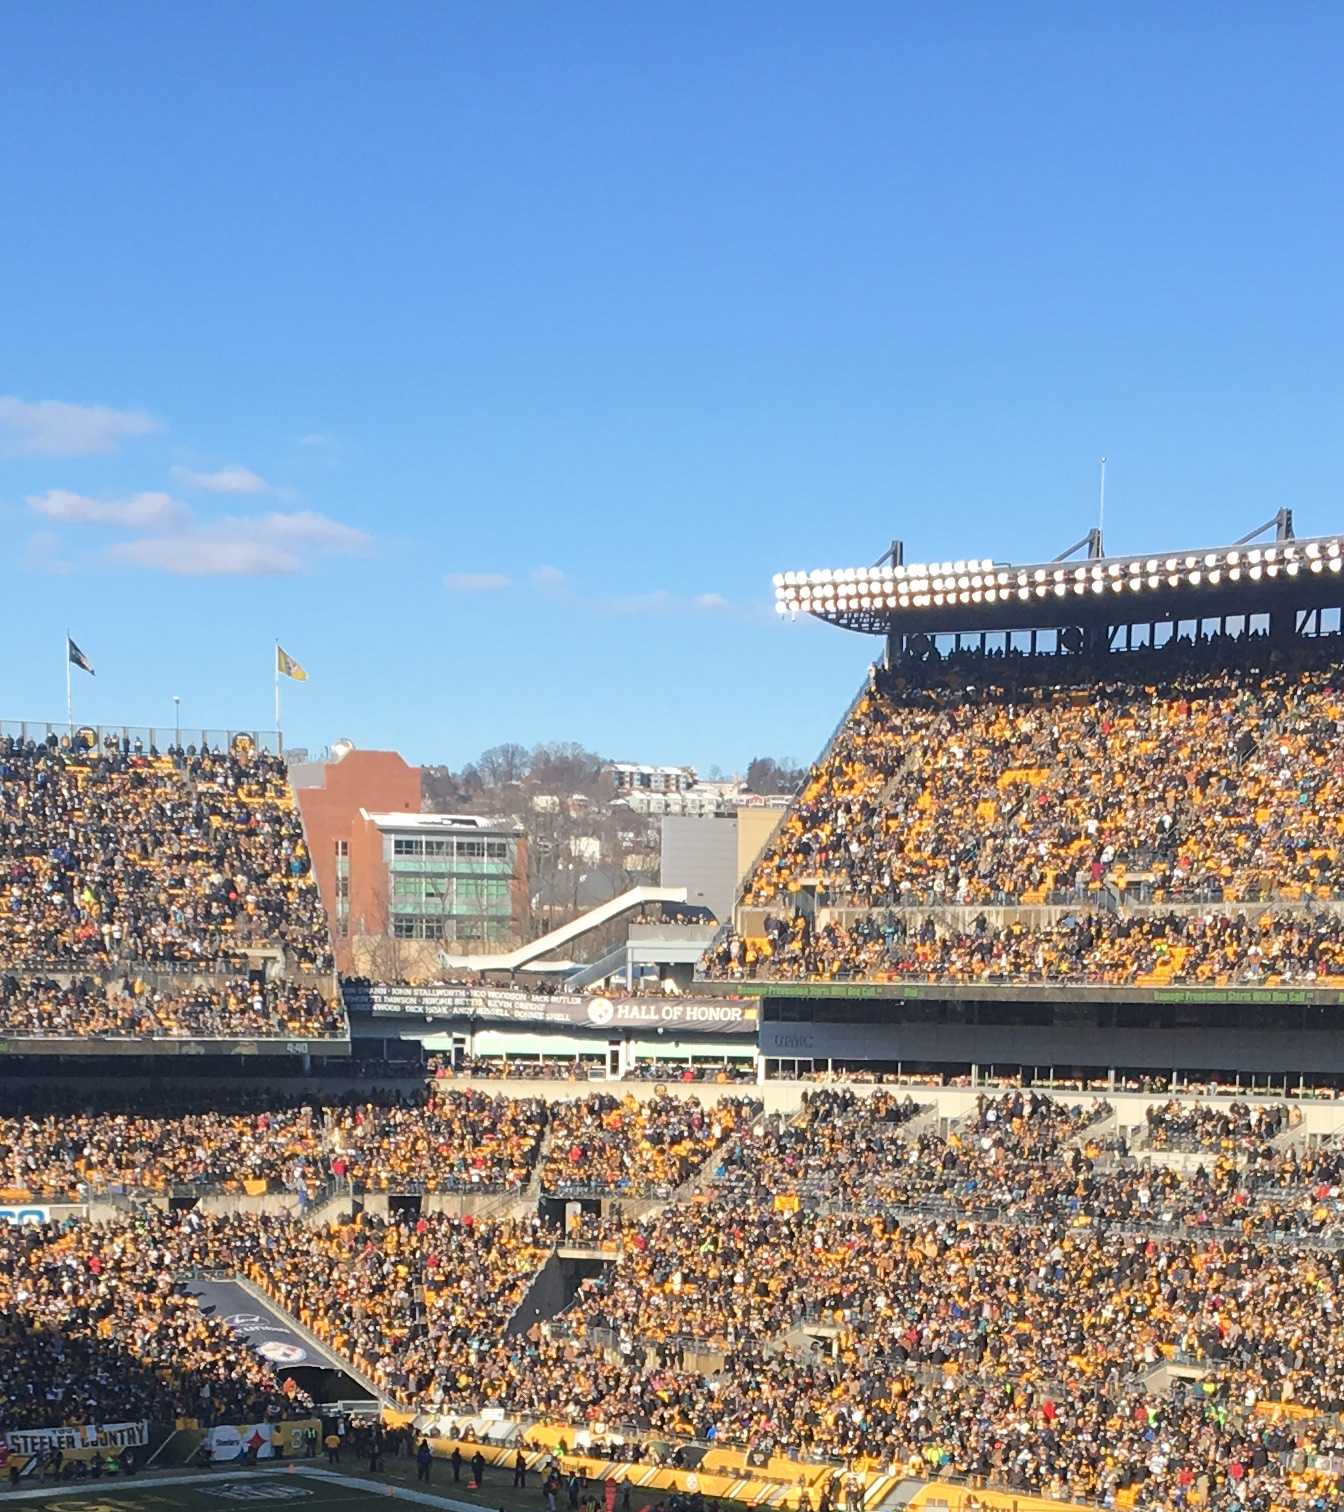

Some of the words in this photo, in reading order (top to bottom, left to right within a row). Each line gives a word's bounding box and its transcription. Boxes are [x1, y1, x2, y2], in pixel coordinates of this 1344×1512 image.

[410, 989, 465, 997] STALLWORTH
[488, 991, 526, 1000] WOODSON
[555, 996, 582, 1004] BUTLER
[617, 1004, 659, 1020] HALL
[662, 1006, 683, 1020] OF
[687, 1006, 742, 1021] HONOR
[10, 1434, 76, 1454] STEELER
